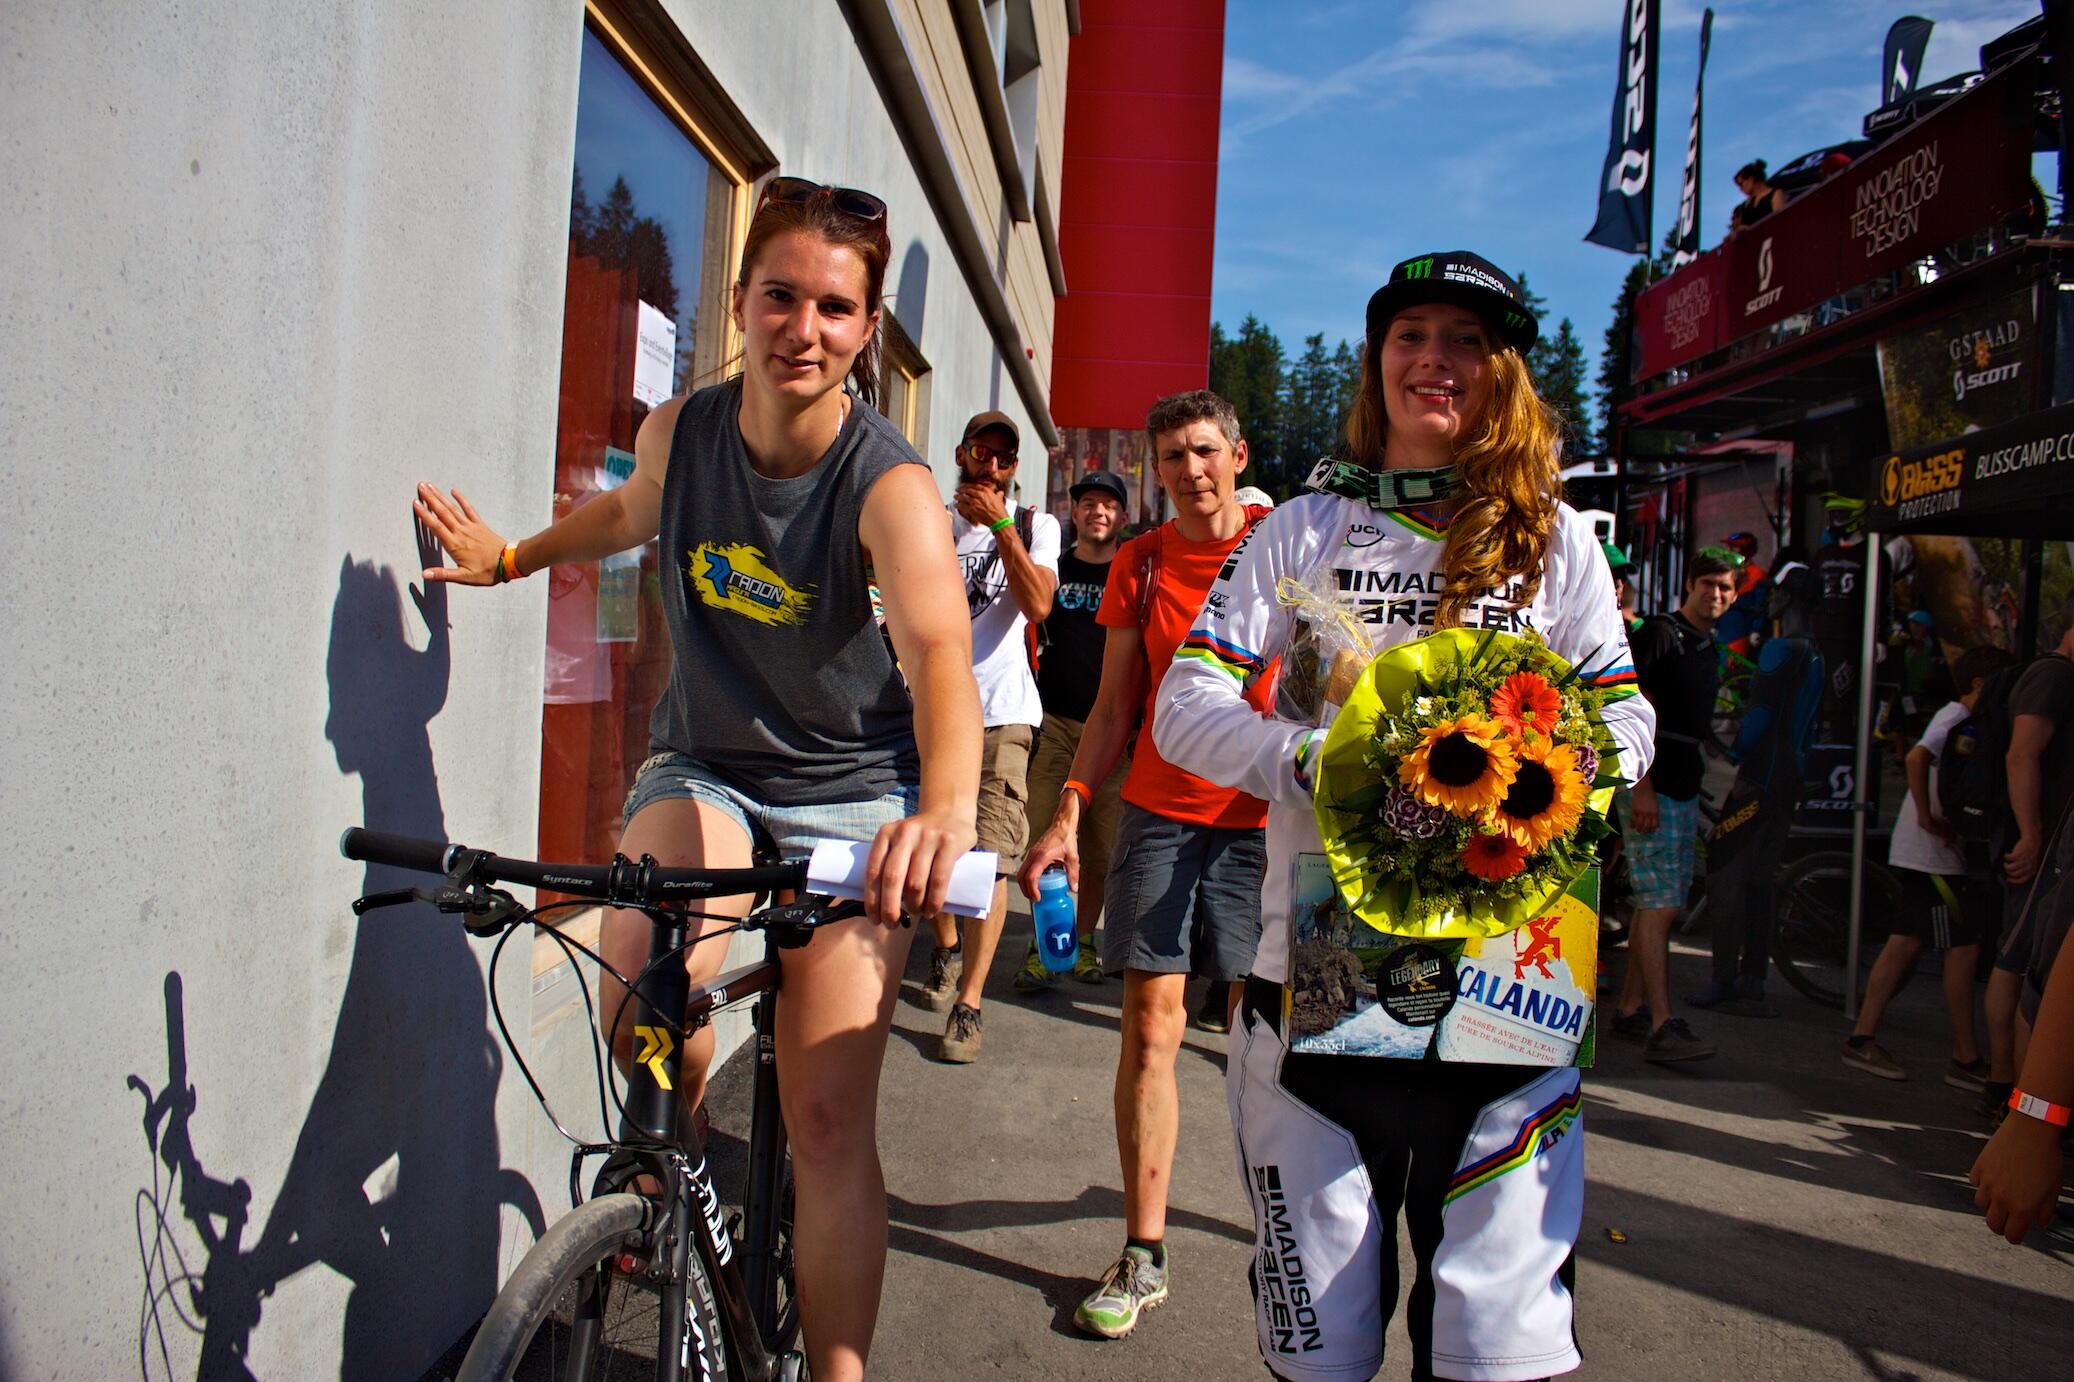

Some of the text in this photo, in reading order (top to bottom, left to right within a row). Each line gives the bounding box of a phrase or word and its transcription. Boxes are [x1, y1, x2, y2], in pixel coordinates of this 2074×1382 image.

[1856, 139, 1938, 210] INNOVATION
[1850, 164, 1944, 240] TECHNOLOGY
[1866, 207, 1920, 258] DESIGN
[1459, 264, 1506, 295] MADISON
[1743, 285, 1784, 317] SCOTT
[1949, 319, 2020, 361] GSTAAD
[1966, 361, 2022, 391] SCOTT
[1900, 448, 1966, 501] BLISS
[1897, 488, 1962, 521] PROTECTION
[1351, 524, 1381, 536] UCI
[1366, 570, 1525, 601] MADON
[542, 874, 593, 886] Syntace
[1390, 958, 1440, 986] LEGENDARY
[1457, 965, 1584, 1037] CALANDA
[1456, 1023, 1556, 1065] PURE DE SOURCE ALPINE
[1498, 1028, 1520, 1042] AVEC
[1521, 1037, 1533, 1047] DE
[1270, 1204, 1324, 1353] MADISON
